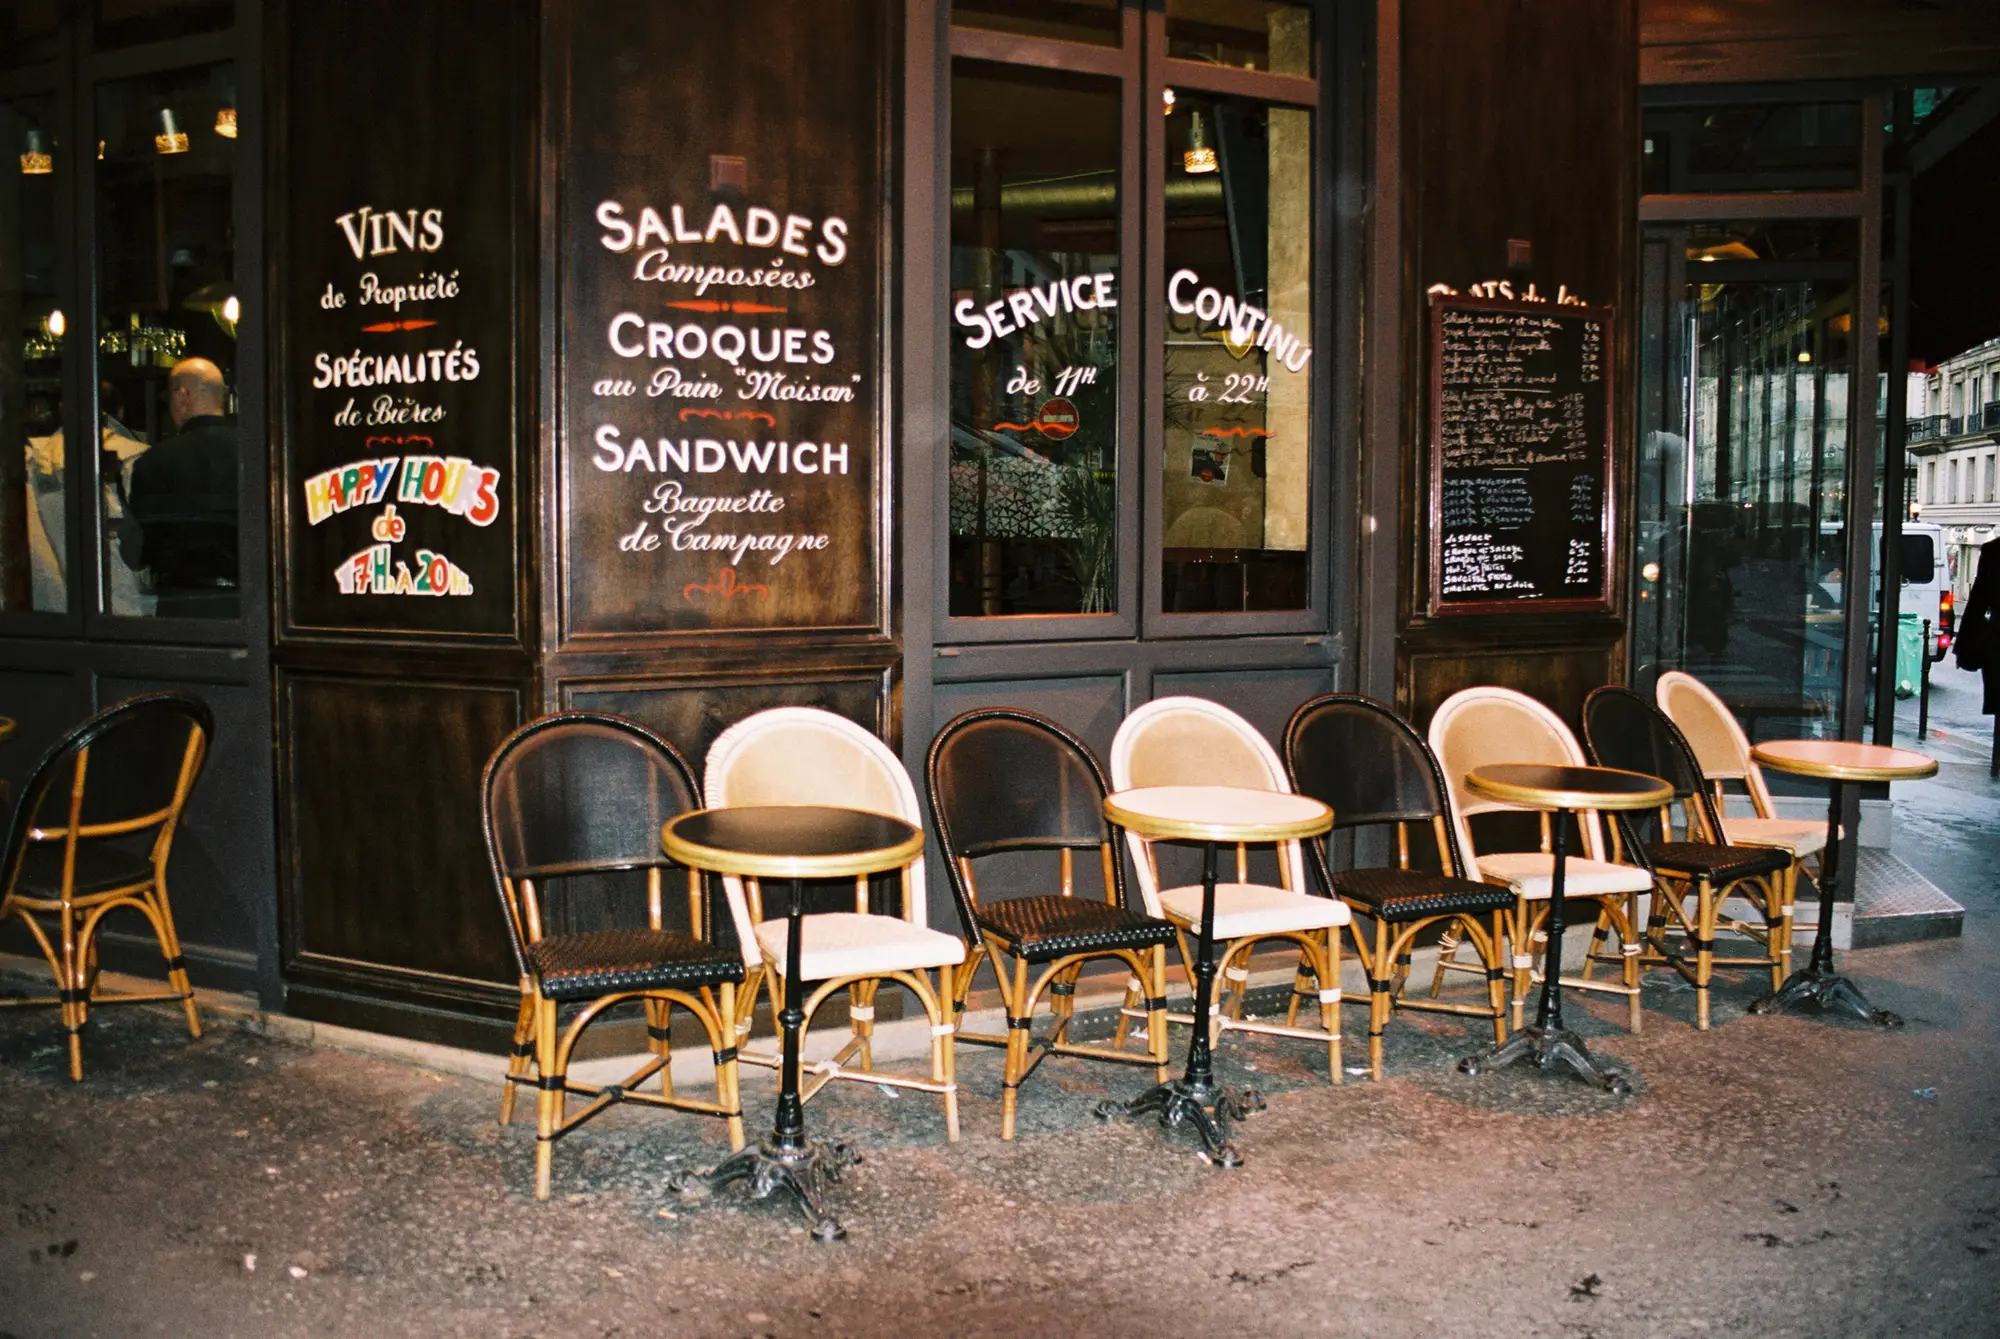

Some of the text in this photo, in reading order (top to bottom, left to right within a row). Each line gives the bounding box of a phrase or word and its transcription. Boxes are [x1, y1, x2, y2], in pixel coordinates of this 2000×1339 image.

[335, 206, 444, 262] VINS
[595, 200, 849, 266] SALADES
[320, 269, 460, 313] de Propriété
[633, 248, 817, 297] Composées
[608, 312, 835, 366] CROQUES
[955, 269, 1312, 373] SERVICE CONTINU
[312, 340, 481, 389] SPÉCIALITÉS
[592, 376, 637, 397] au
[645, 366, 723, 398] Pain
[1006, 366, 1041, 396] de
[334, 398, 362, 427] de
[592, 423, 849, 475] SANDWICH
[304, 456, 500, 527] HAPPY HOURS
[642, 480, 786, 528] Baguette
[372, 503, 406, 542] de
[618, 516, 832, 566] de Campagne
